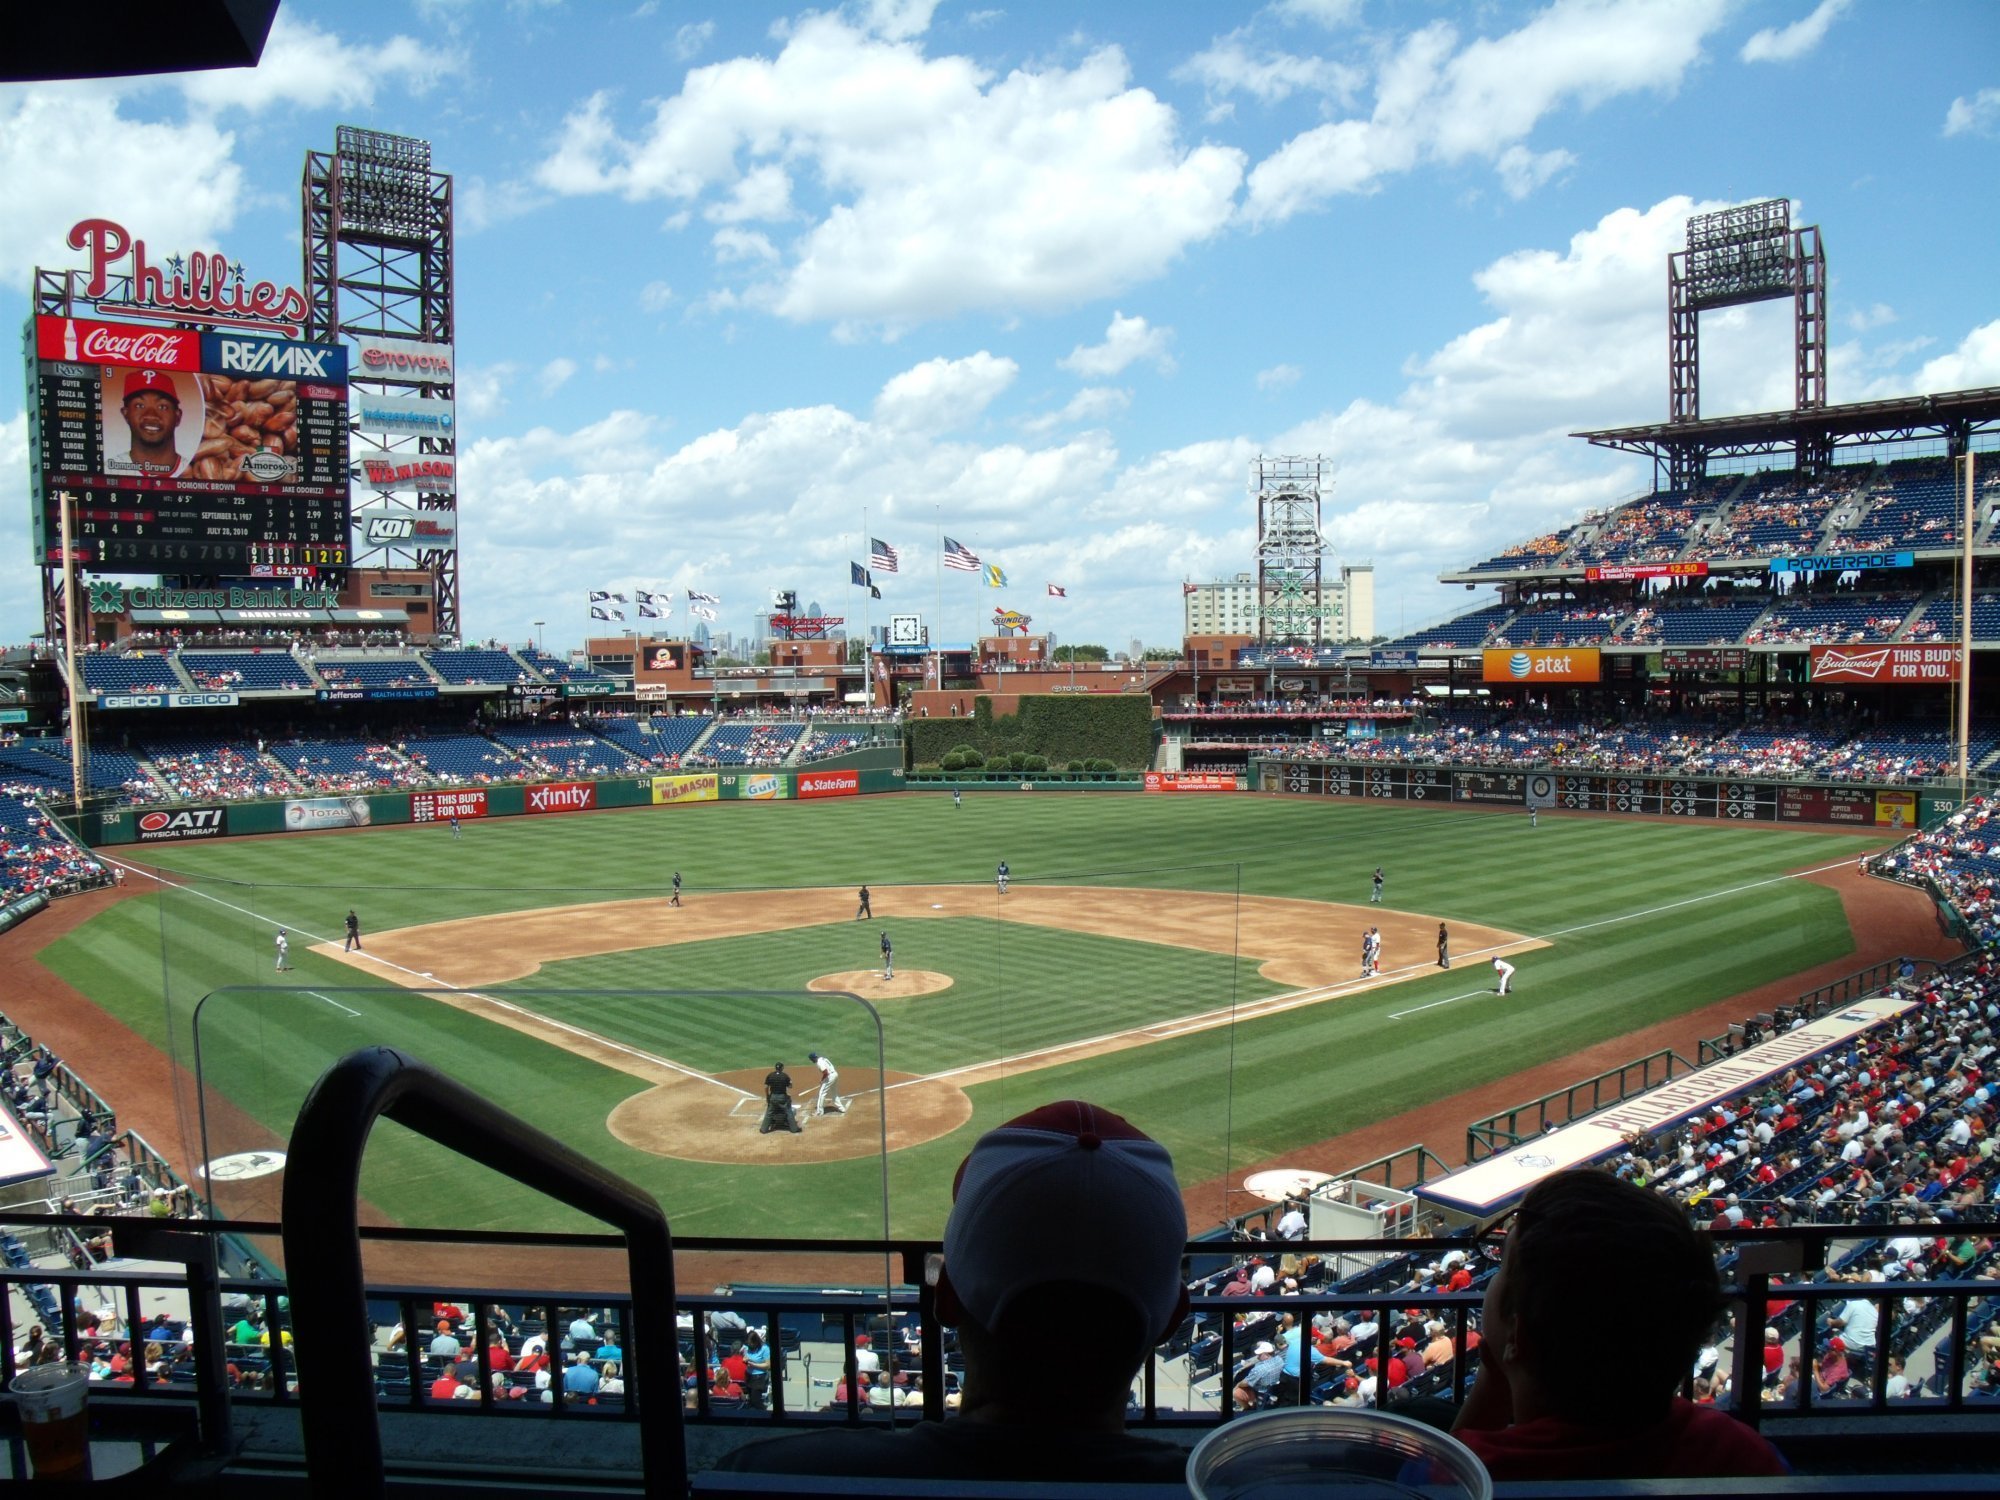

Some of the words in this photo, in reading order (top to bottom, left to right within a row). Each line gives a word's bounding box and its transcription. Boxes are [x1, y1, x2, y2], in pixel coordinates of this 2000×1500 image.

[67, 218, 309, 322] Phillies
[84, 328, 183, 366] Coca-Cola
[221, 340, 327, 378] RE/MAX
[385, 352, 450, 370] TOYOTA
[105, 368, 112, 378] 9
[57, 400, 86, 409] LONGORIA
[363, 407, 438, 424] Independence
[62, 421, 83, 429] BUTLER
[60, 431, 86, 440] BECKHAM
[64, 452, 84, 460] RIVERA
[108, 459, 143, 471] Domonic
[145, 462, 170, 473] Brown
[177, 481, 209, 490] DOMONIC
[211, 483, 236, 491] BROWN
[110, 493, 117, 503] 8
[136, 494, 142, 504] 7
[233, 497, 245, 505] 225
[268, 510, 273, 518] 5
[84, 523, 95, 533] 21
[112, 524, 118, 534] 4
[137, 525, 143, 535] 8
[207, 527, 221, 535] JULY
[368, 519, 415, 538] KDI
[264, 532, 279, 540] 87.1
[99, 552, 105, 561] 2
[305, 551, 311, 563] 1
[320, 550, 327, 563] 2
[335, 551, 343, 563] 2
[1787, 554, 1897, 570] POWERADE
[276, 567, 309, 576] $2,370
[1670, 564, 1698, 573] $2.50
[129, 587, 227, 609] Citizens
[229, 586, 288, 609] Bank
[290, 586, 340, 609] Park
[1243, 604, 1301, 618] Citizens
[1305, 604, 1341, 618] Bank
[995, 616, 1029, 624] SUNOCO
[1276, 621, 1308, 633] Park
[1893, 650, 1921, 663] THIS
[1535, 655, 1571, 674] at&t
[1814, 656, 1887, 670] Budweiser
[1893, 664, 1917, 677] FOR
[1920, 664, 1949, 677] YOU.
[371, 690, 395, 698] HEALTH
[414, 689, 424, 697] WE
[425, 689, 435, 697] DO
[521, 685, 557, 694] NovaCare
[575, 684, 610, 693] NovaCare
[178, 694, 231, 706] GEICO
[329, 690, 363, 700] Jefferson
[105, 696, 162, 708] GEICO
[892, 769, 904, 777] 409
[637, 780, 650, 789] 374
[722, 776, 736, 785] 387
[748, 779, 778, 795] Gulf
[1020, 783, 1033, 791] 401
[437, 794, 458, 805] THIS
[459, 792, 485, 804] BUD'S
[530, 785, 591, 811] xfinity
[437, 806, 455, 817] FOR
[456, 804, 477, 815] YOU.
[1933, 801, 1953, 812] 330
[102, 813, 120, 825] 334
[167, 809, 222, 829] ATI
[141, 829, 181, 839] PHYSICAL
[182, 826, 219, 837] THERAPY
[1589, 1066, 1763, 1133] PHILADELPHIA
[1745, 1031, 1836, 1065] PHILLIES
